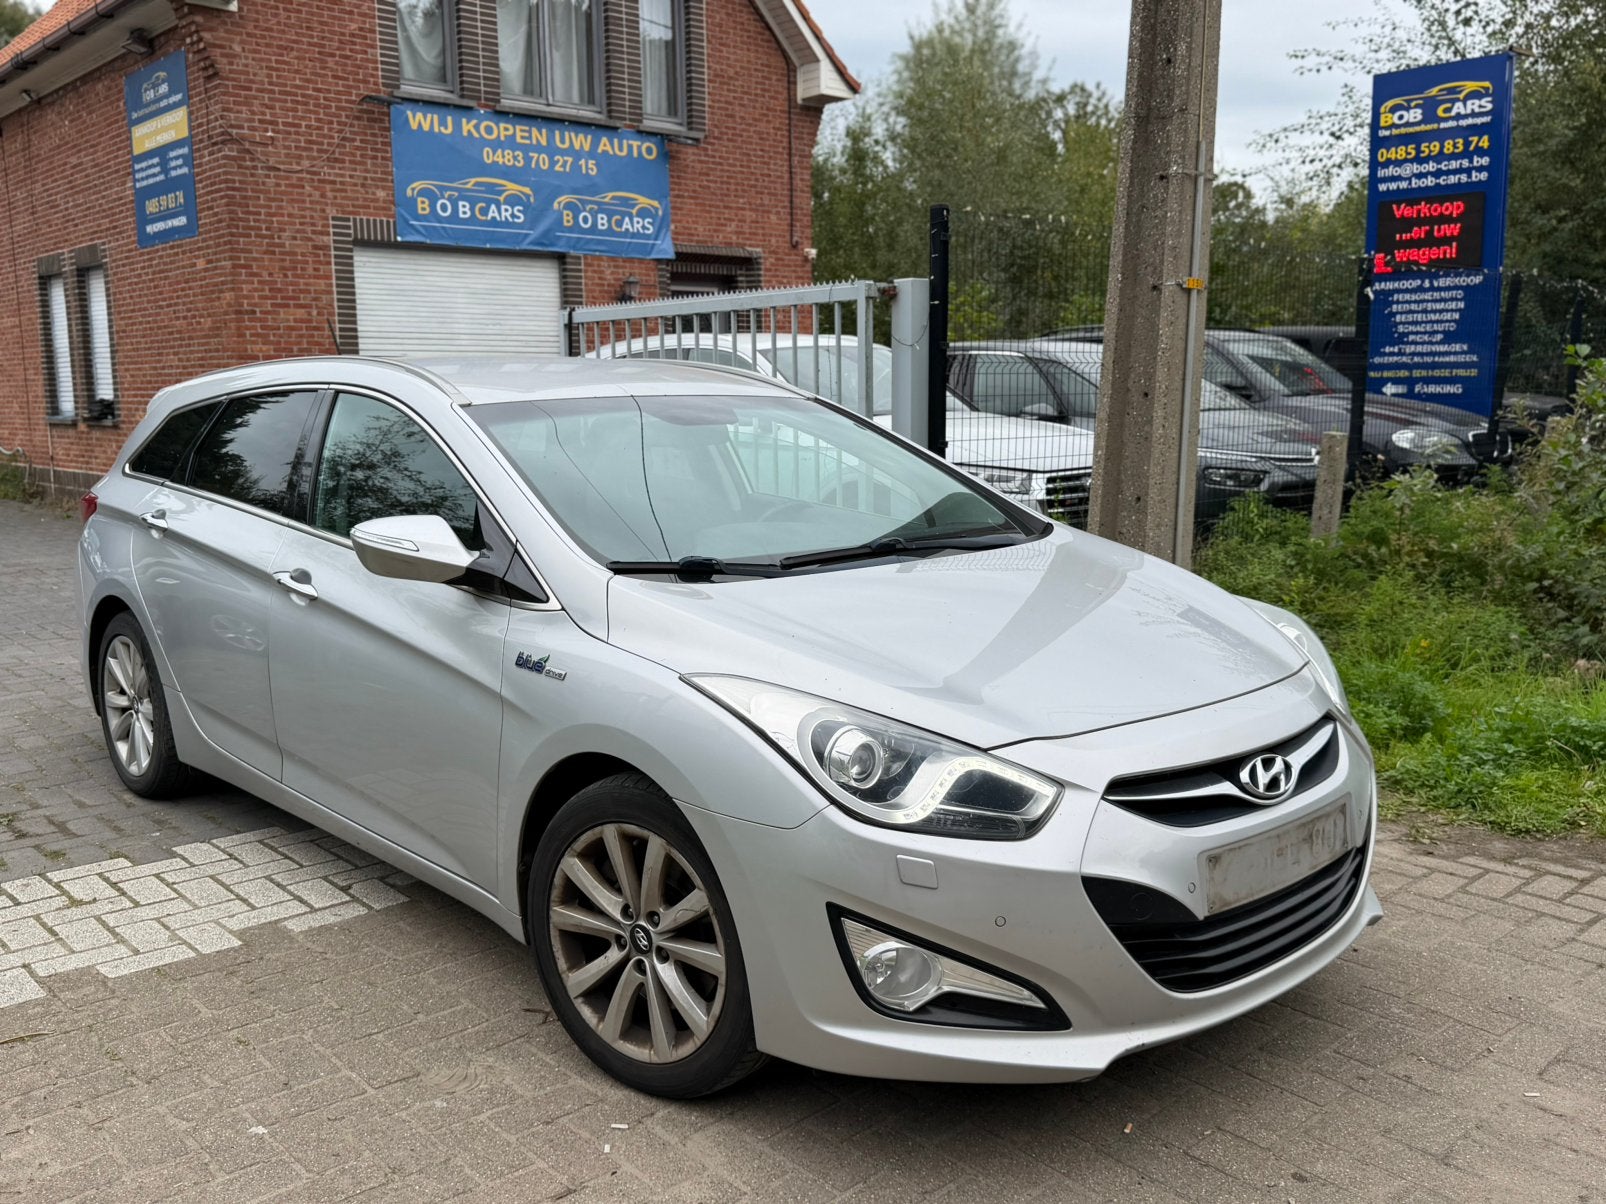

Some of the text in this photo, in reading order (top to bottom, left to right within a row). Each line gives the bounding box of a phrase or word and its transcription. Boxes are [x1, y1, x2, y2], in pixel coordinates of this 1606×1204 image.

[1380, 97, 1493, 127] BOB CARS
[408, 110, 658, 160] WIJ KOPEN UW AUTO
[1378, 129, 1391, 137] Uw
[1440, 120, 1457, 129] auto
[1458, 116, 1492, 128] opkoper
[1378, 135, 1490, 162] 0485 59 83 74
[483, 147, 598, 176] 0483 70 27 15
[1378, 155, 1490, 178] info@bob-cars.be
[1378, 170, 1488, 192] www.bob-cars.be
[475, 203, 525, 223] CARS
[1392, 201, 1465, 218] Verkoop
[611, 215, 654, 234] CARS
[1434, 223, 1462, 238] uw
[1394, 242, 1458, 264] wagen!
[1373, 276, 1484, 291] AANKOOP & VERKOOP
[1414, 384, 1463, 394] PARKING
